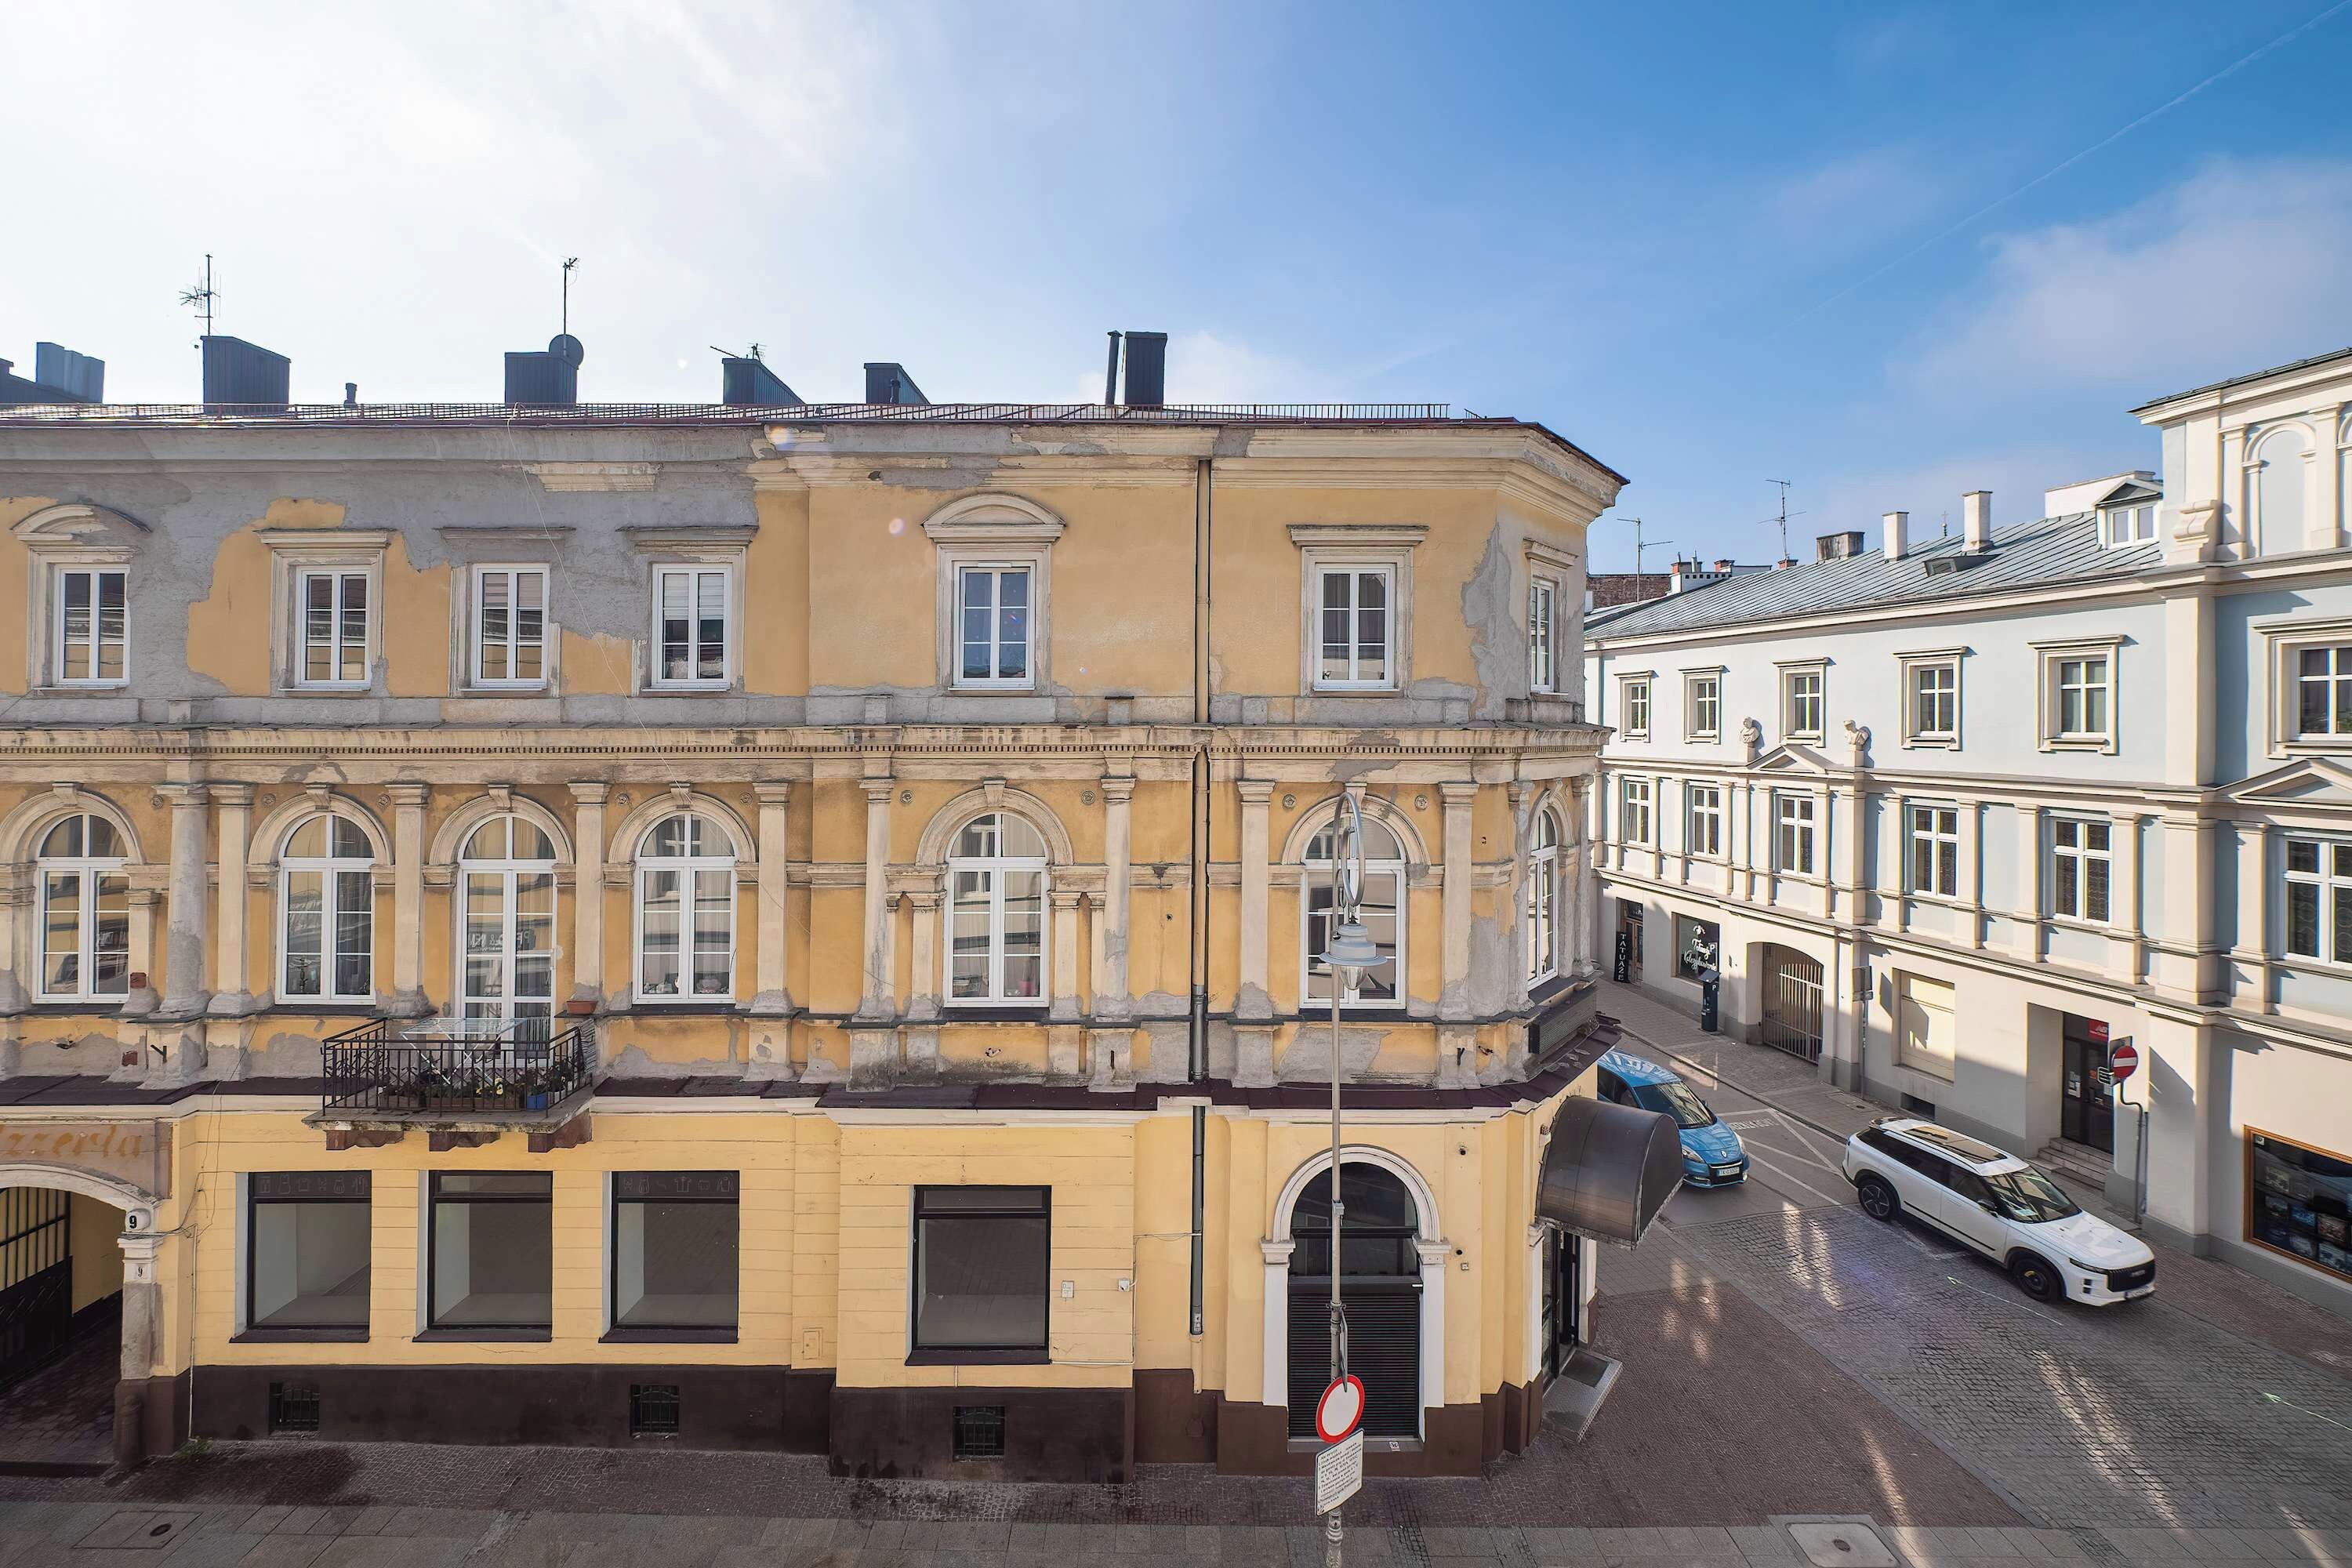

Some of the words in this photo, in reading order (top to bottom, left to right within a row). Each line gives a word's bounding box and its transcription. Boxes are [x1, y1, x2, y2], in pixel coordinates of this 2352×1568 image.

[1710, 944, 1715, 953] P
[129, 1215, 137, 1229] 9
[138, 1266, 143, 1278] 9
